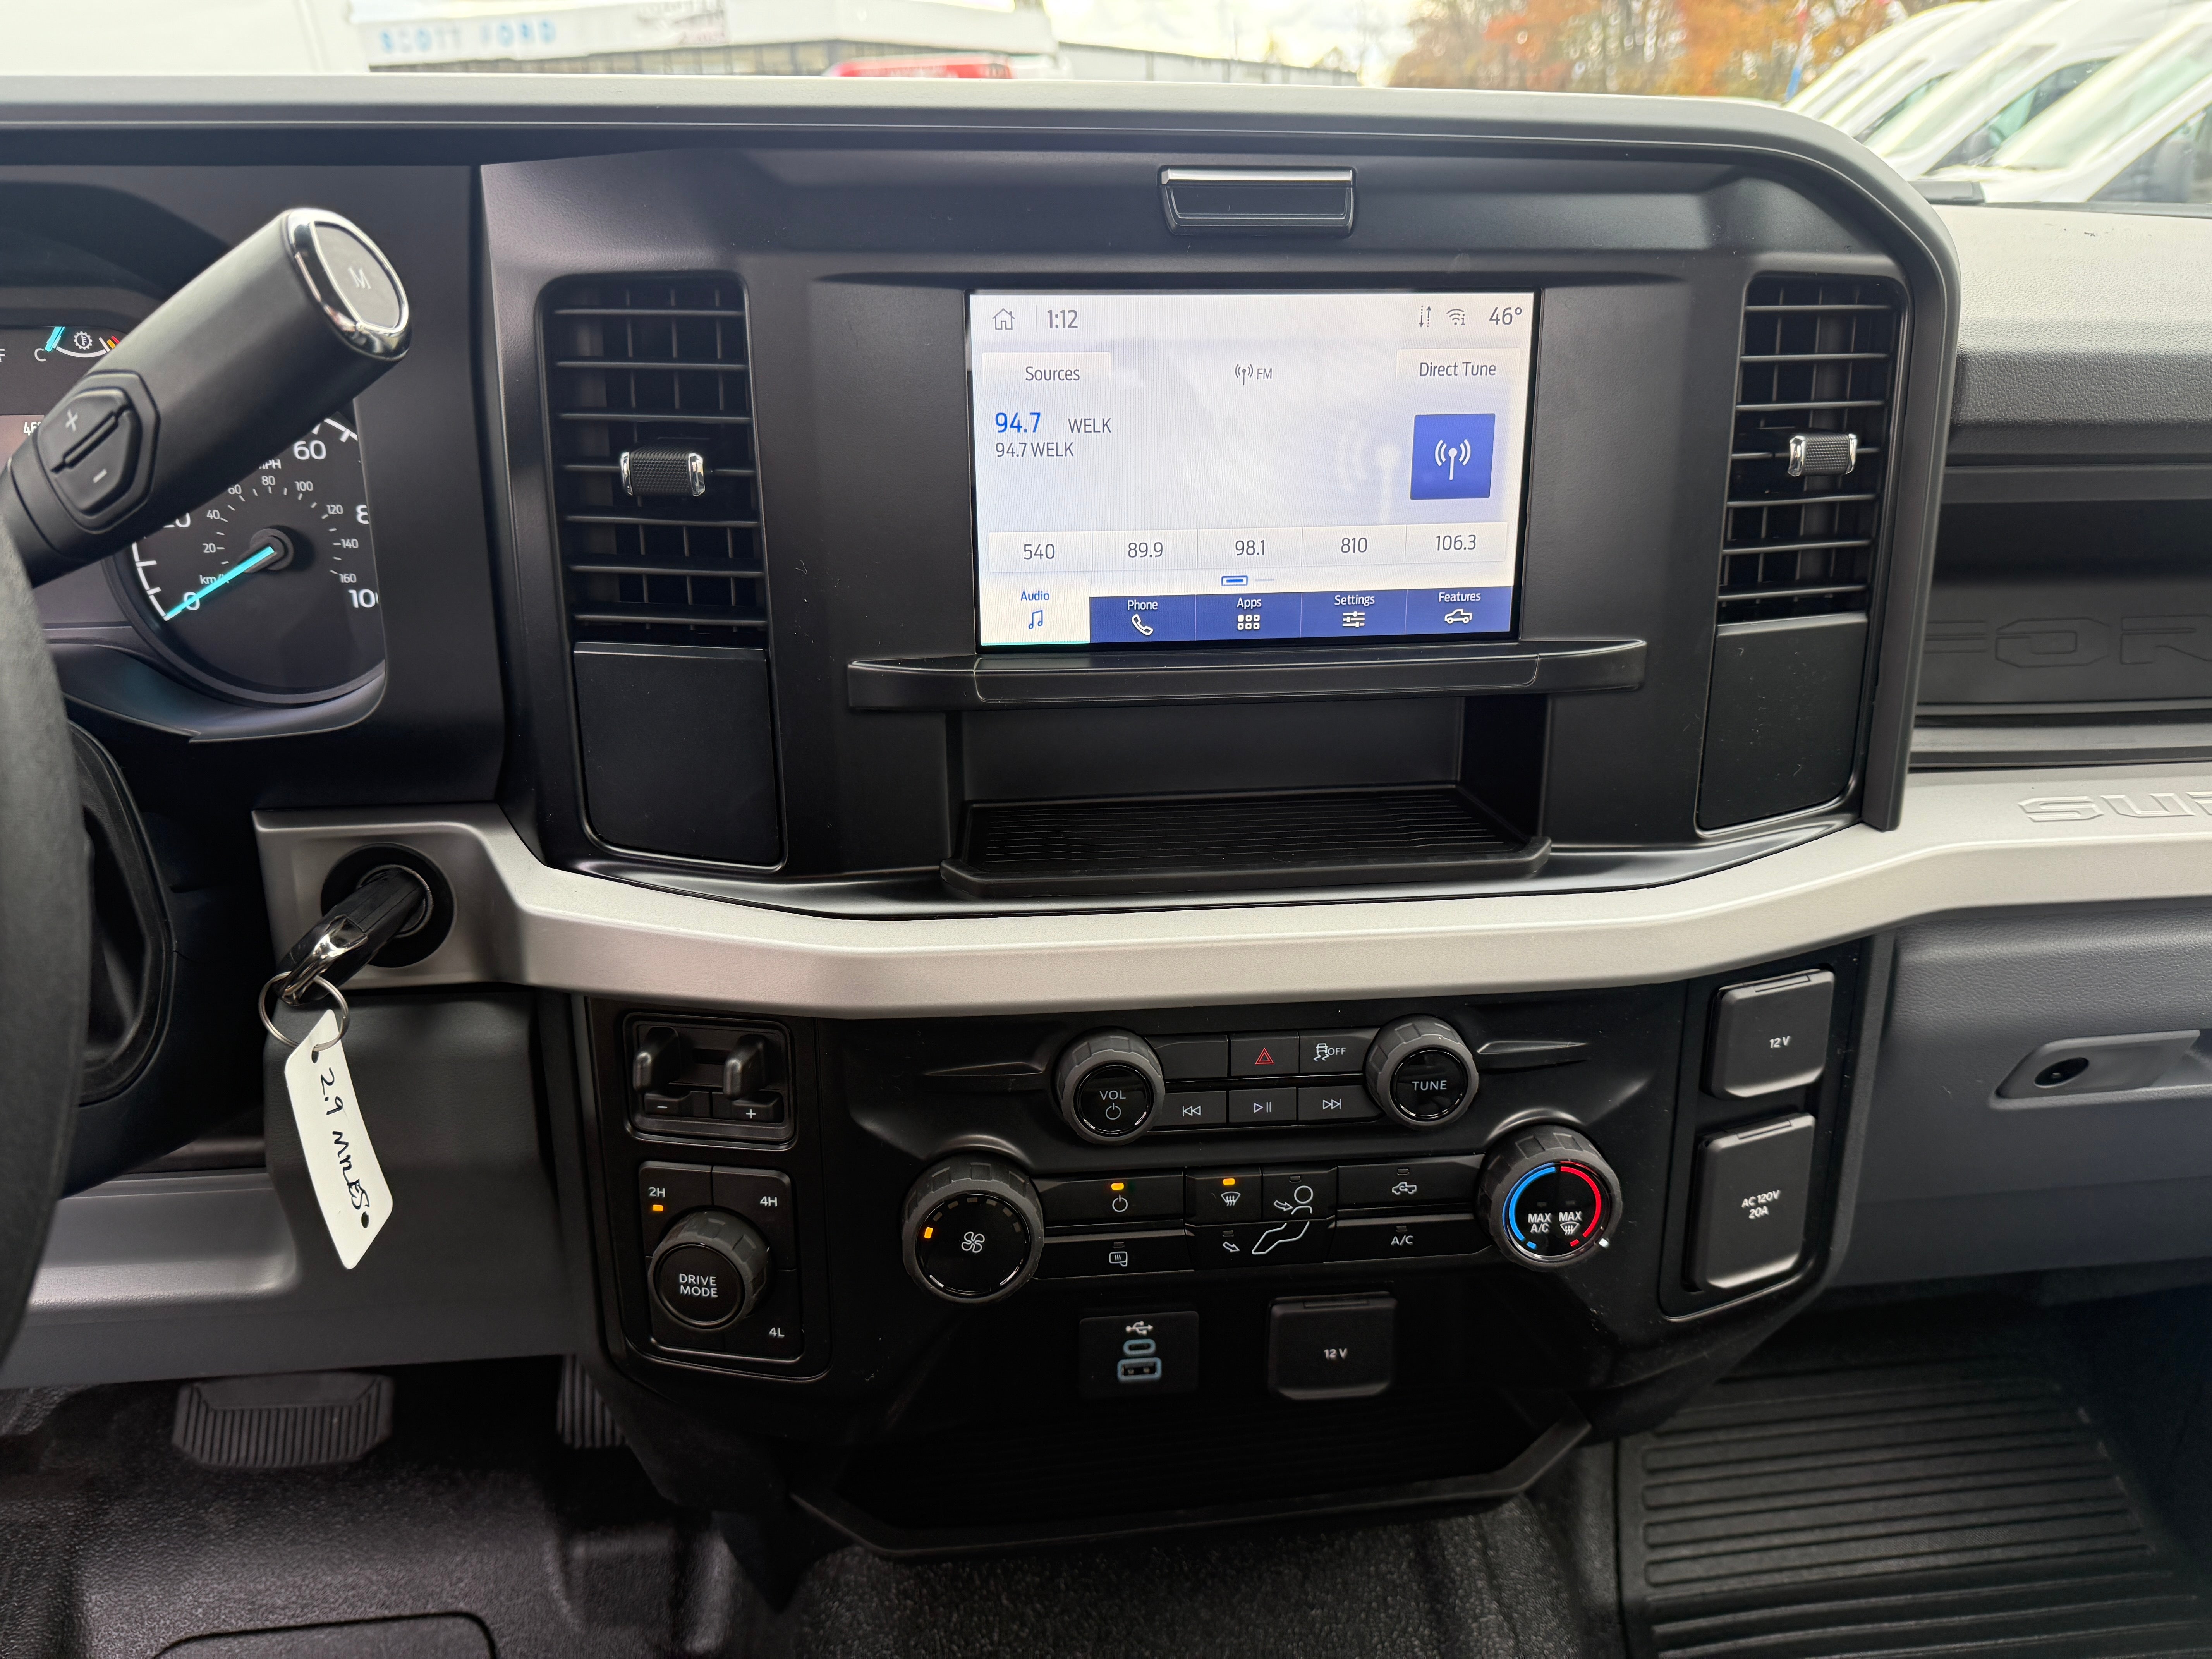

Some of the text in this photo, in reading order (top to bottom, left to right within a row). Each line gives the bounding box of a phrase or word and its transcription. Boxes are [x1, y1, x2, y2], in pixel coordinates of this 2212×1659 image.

[1047, 309, 1078, 329] 1:12
[1489, 307, 1522, 325] 46°
[34, 348, 46, 362] C
[1025, 366, 1080, 381] Sources
[1257, 368, 1272, 380] FM
[1419, 361, 1497, 377] Direct Tune
[995, 412, 1111, 433] 94.7 WELK
[294, 440, 326, 460] 60
[996, 442, 1074, 457] 94.7 WELK
[261, 476, 275, 486] 80
[295, 481, 314, 492] 100
[206, 510, 220, 519] 40
[326, 504, 343, 515] 120
[203, 543, 216, 553] 20
[341, 539, 359, 549] 140
[1235, 540, 1265, 556] 98.1
[1341, 537, 1367, 553] 810
[1436, 534, 1476, 551] 106.3
[1024, 544, 1055, 560] 540
[1128, 542, 1163, 558] 89.9
[339, 574, 357, 584] 160
[1020, 590, 1049, 601] Audio
[1334, 594, 1375, 608] Settings
[1438, 592, 1481, 602] Features
[1127, 599, 1158, 610] Phone
[1237, 597, 1262, 610] Apps
[1769, 1036, 1790, 1048] 12 V
[1328, 1047, 1346, 1055] OFF
[320, 1067, 344, 1116] 2.9
[1412, 1080, 1447, 1091] TUNE
[1099, 1090, 1126, 1100] VOL
[649, 1187, 666, 1197] 2H
[760, 1196, 778, 1207] 4H
[1741, 1190, 1780, 1209] AC 120V
[1528, 1213, 1551, 1223] MAX
[1559, 1211, 1581, 1221] MAX
[1748, 1206, 1769, 1219] 20A
[1530, 1223, 1549, 1233] A/C
[1391, 1235, 1413, 1245] A/C
[679, 1273, 717, 1286] DRIVE
[680, 1284, 718, 1297] MODE
[769, 1327, 785, 1337] 4L
[1324, 1348, 1347, 1358] 12 V
